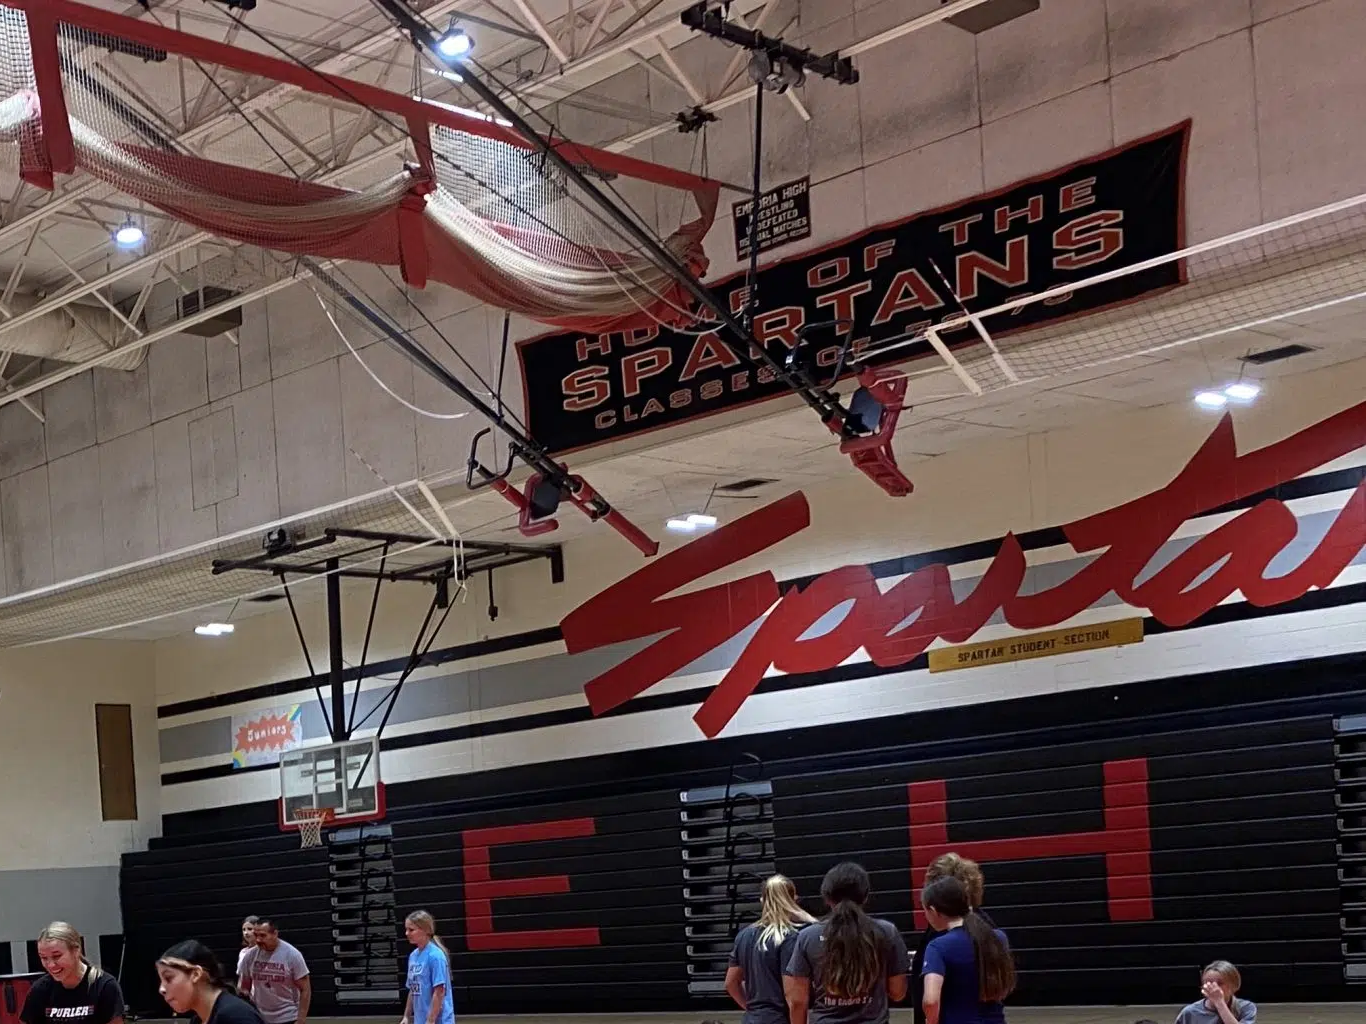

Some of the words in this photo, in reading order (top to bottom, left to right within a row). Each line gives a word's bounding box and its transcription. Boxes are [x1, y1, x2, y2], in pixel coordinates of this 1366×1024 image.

[773, 216, 808, 236] MATCHES
[782, 182, 807, 200] HIGH
[807, 239, 896, 288] OF
[938, 176, 1097, 246] THE
[561, 209, 1124, 411] SPARTANS
[594, 365, 779, 430] CLASSES
[559, 400, 1366, 740] Sparta
[958, 647, 1004, 663] SPARTAN
[1010, 639, 1056, 655] STUDENT
[1064, 630, 1109, 645] SECTION
[462, 818, 600, 952] E
[908, 758, 1154, 931] H
[49, 1006, 89, 1018] PURLER
